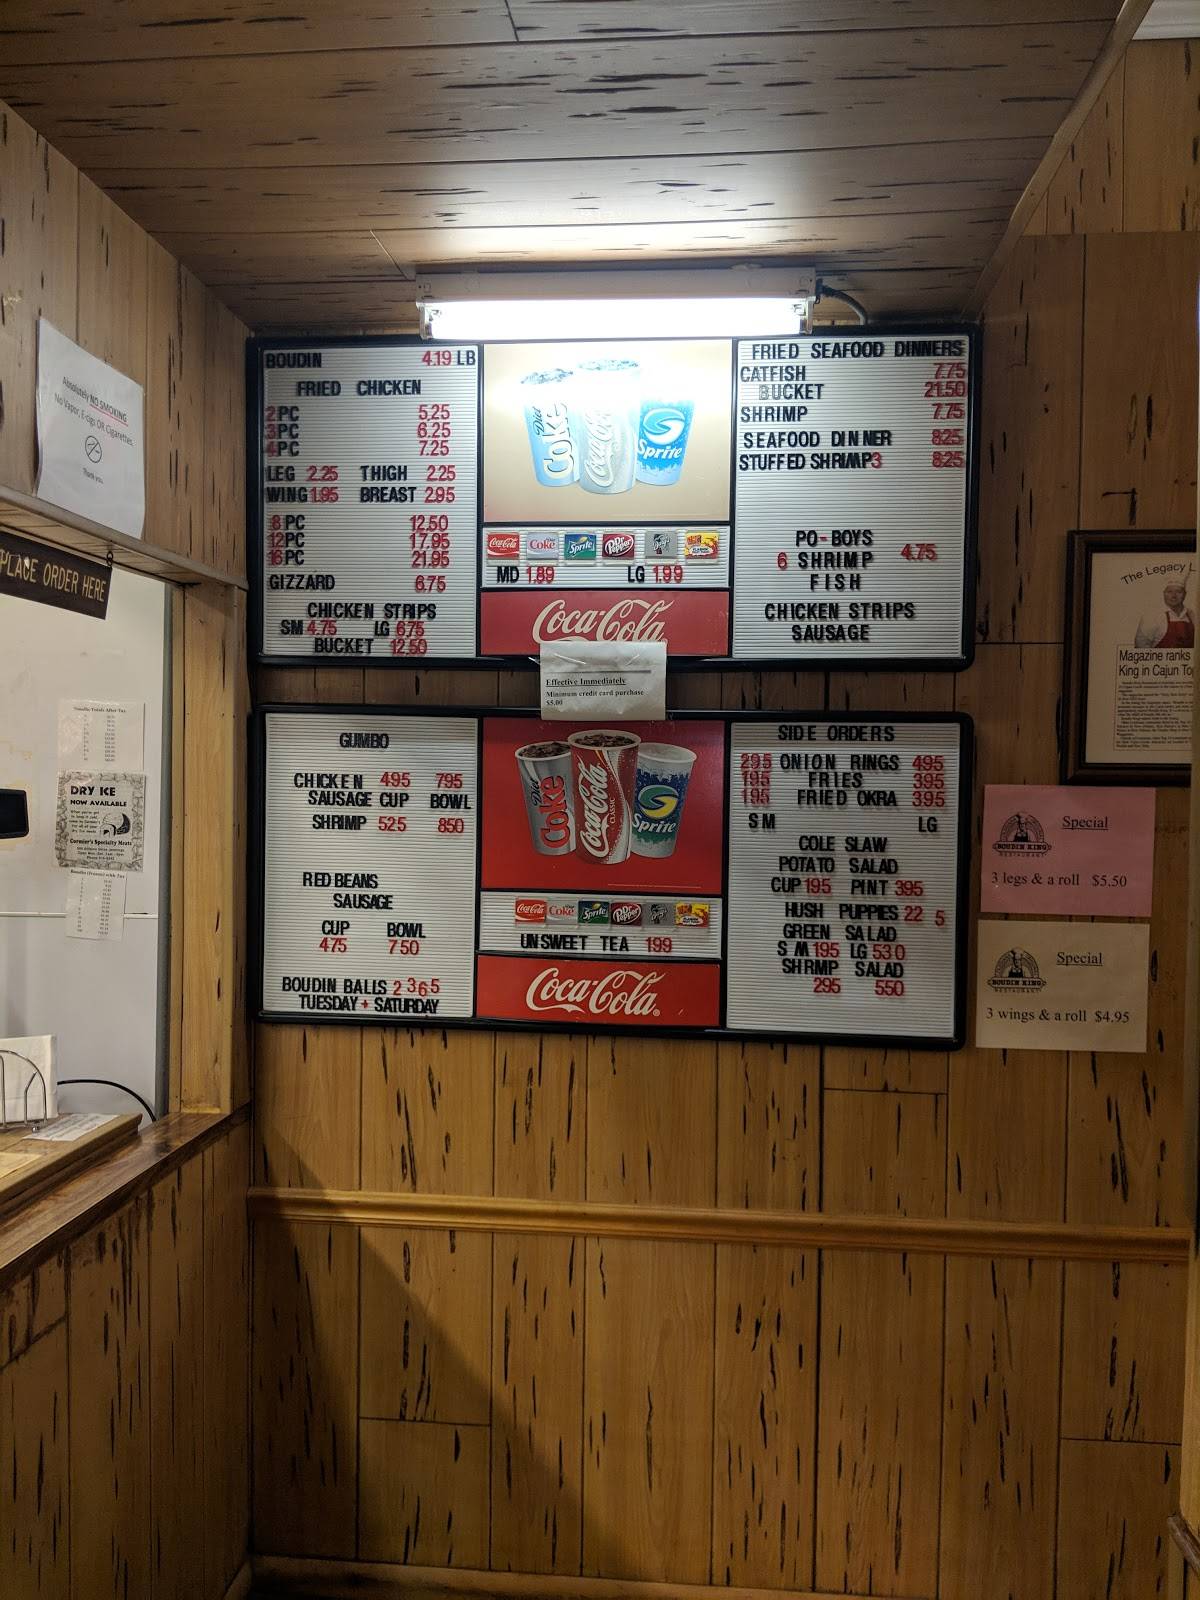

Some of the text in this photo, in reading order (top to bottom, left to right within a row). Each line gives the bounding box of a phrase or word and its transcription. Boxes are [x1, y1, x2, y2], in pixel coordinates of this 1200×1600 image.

[752, 340, 964, 360] FRIED SEAFOOD DINNERS
[266, 350, 476, 368] BOUDIN 4.19 LB
[740, 366, 806, 382] CATFISH
[297, 380, 421, 396] FRIED CHICKEN
[759, 384, 824, 400] BUCKET
[54, 392, 64, 405] No
[62, 375, 127, 423] Absolutely NO SMOKING
[419, 404, 450, 422] 5.25
[740, 406, 808, 423] SHRIMP
[417, 422, 451, 438] 6.25
[419, 440, 450, 456] 7.25
[744, 430, 892, 449] SEAFOOD DINNER
[637, 439, 682, 459] Sprite
[739, 454, 805, 471] STUFFED
[267, 466, 408, 482] LEG THIGH
[267, 486, 417, 503] WING BREAST
[409, 515, 449, 531] 12.50
[409, 533, 450, 550] 17.95
[529, 540, 556, 550] Coke
[605, 540, 632, 553] Pepper
[615, 537, 624, 545] Dr
[412, 551, 450, 568] 21.95
[798, 552, 873, 569] SHRIMP
[0, 549, 106, 601] PLACE ORDER HERE
[497, 566, 683, 584] MD 1.89 LG 1.99
[811, 574, 861, 590] FISH
[1121, 570, 1144, 586] The
[1145, 563, 1186, 576] Legacy
[270, 575, 447, 592] GIZZARD 6.75
[307, 602, 436, 619] CHICKEN STRIPS
[765, 602, 915, 620] CHICKEN STRIPS
[280, 620, 390, 637] SM 4.75 LG
[532, 599, 675, 644] Coca-Cola
[792, 624, 870, 642] SAUSAGE
[315, 638, 374, 654] BUCKET
[1119, 649, 1190, 664] Magazine ranks
[1119, 664, 1179, 679] King in Cajun
[546, 677, 627, 686] Effective Immediately
[616, 689, 644, 697] purchase
[340, 733, 389, 749] GUMBO
[778, 725, 895, 742] SIDE ORDERS
[741, 753, 944, 771] 295 ONION RINGS 495
[294, 772, 411, 789] CHICKEN 495
[742, 771, 945, 790] 195 FRIES 395
[70, 786, 116, 796] DRY ICE
[308, 790, 471, 809] SAUSAGE CUP BOWL
[798, 790, 898, 806] FRIED OKRA
[539, 775, 571, 848] Coke
[576, 757, 610, 858] Coca-Cola
[313, 815, 464, 833] SHRIMP 525 850
[632, 813, 677, 833] Sprite
[919, 817, 937, 833] LG
[1062, 816, 1108, 830] Special
[799, 836, 887, 853] COLE SLAW
[779, 857, 898, 874] POTATO SALAD
[303, 872, 378, 889] RED BEANS
[771, 877, 888, 896] CUP 195 PINT
[992, 872, 1127, 887] 3 legs & a roll $5.50
[333, 893, 393, 910] SAUSAGE
[549, 907, 575, 916] Coke
[786, 902, 898, 920] HUSH PUPPIES
[322, 920, 426, 938] CUP BOWL
[783, 924, 896, 942] GREEN SALAD
[319, 937, 348, 953] 475
[600, 936, 672, 953] TEA 199
[813, 942, 867, 959] 195 LG
[1057, 952, 1103, 966] Special
[855, 962, 904, 978] SALAD
[282, 977, 387, 995] BOUDIN BALLS
[526, 967, 665, 1016] Coca-Cola
[814, 978, 904, 996] 295 550
[299, 995, 439, 1014] TUESDAY SATURDAY
[986, 1008, 1129, 1023] 3 wings & a roll $4.95
